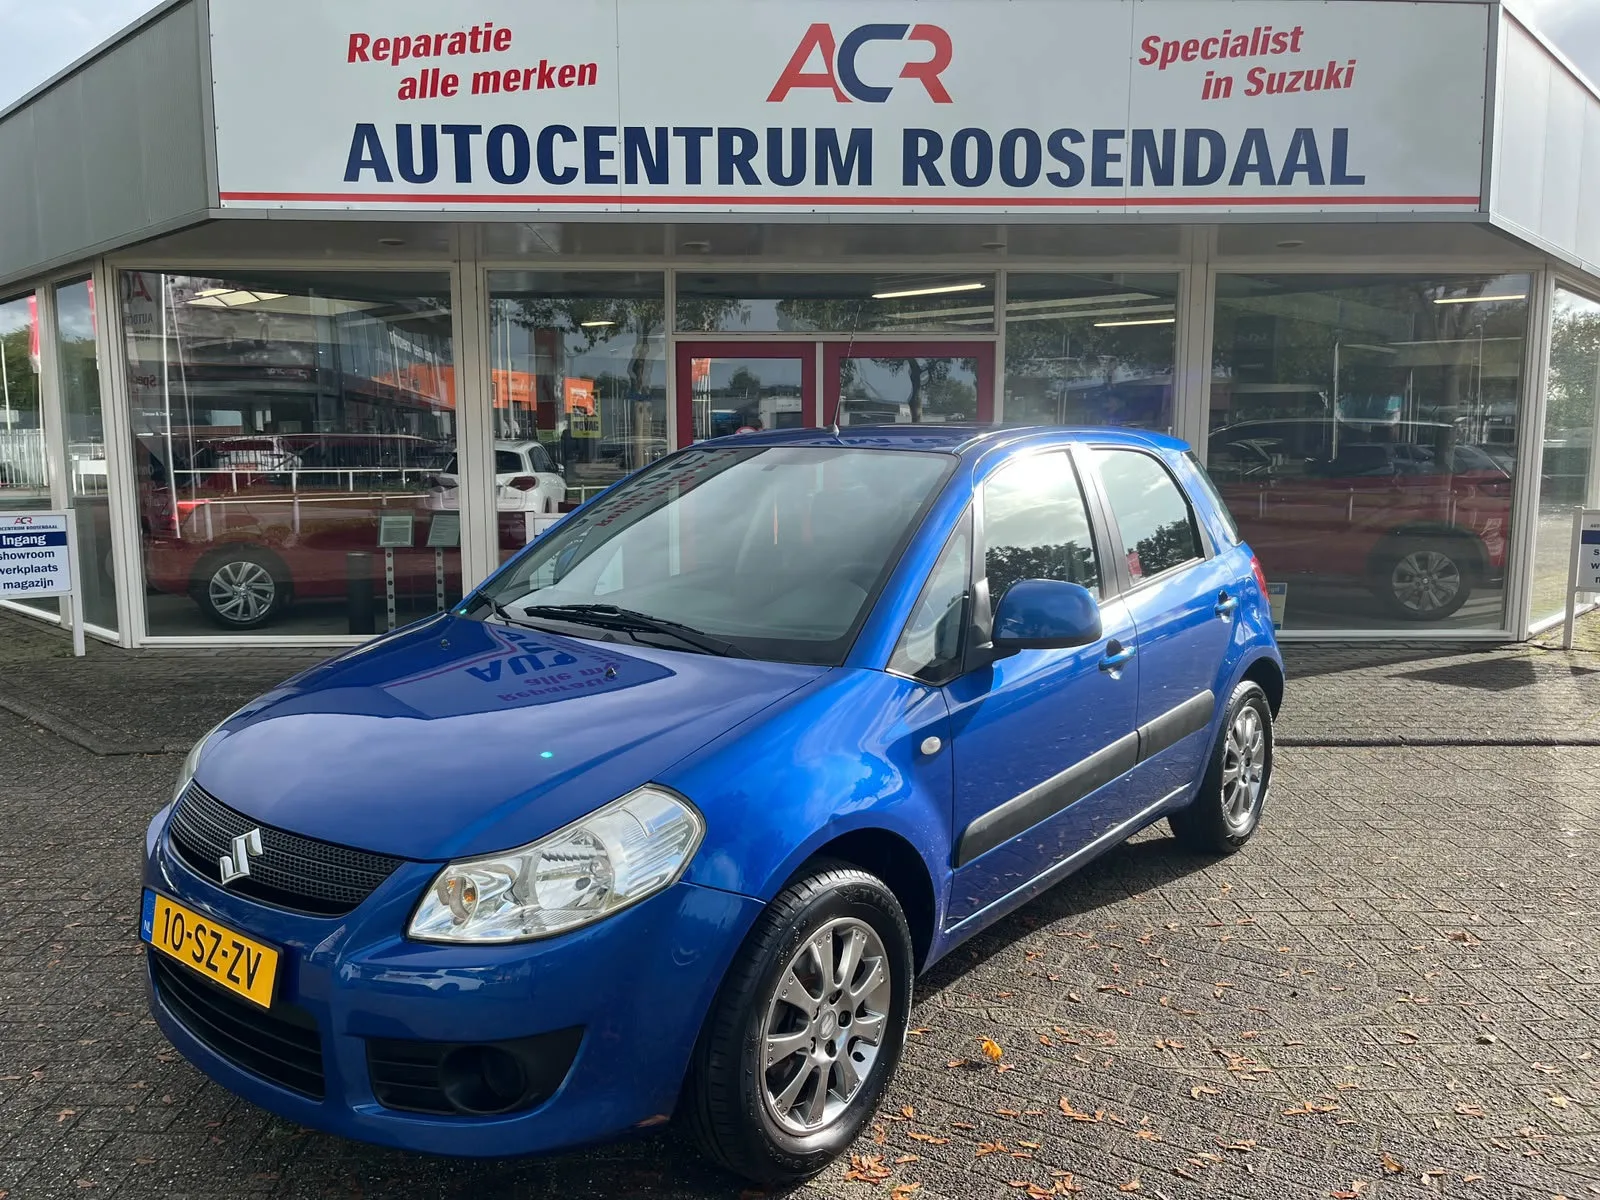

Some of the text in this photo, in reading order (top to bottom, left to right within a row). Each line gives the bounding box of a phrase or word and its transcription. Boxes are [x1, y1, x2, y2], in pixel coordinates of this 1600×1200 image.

[347, 22, 513, 66] Reparatie
[768, 23, 953, 104] ACR
[1140, 26, 1304, 70] Specialist
[397, 61, 598, 100] alle merken
[1202, 59, 1356, 100] in Suzuki
[344, 123, 1366, 189] AUTOCENTRUM ROOSENDAAL
[2, 535, 46, 546] Ingang
[3, 577, 54, 590] magazijn
[143, 919, 152, 934] NL
[163, 907, 263, 991] 10-SZ-ZV
